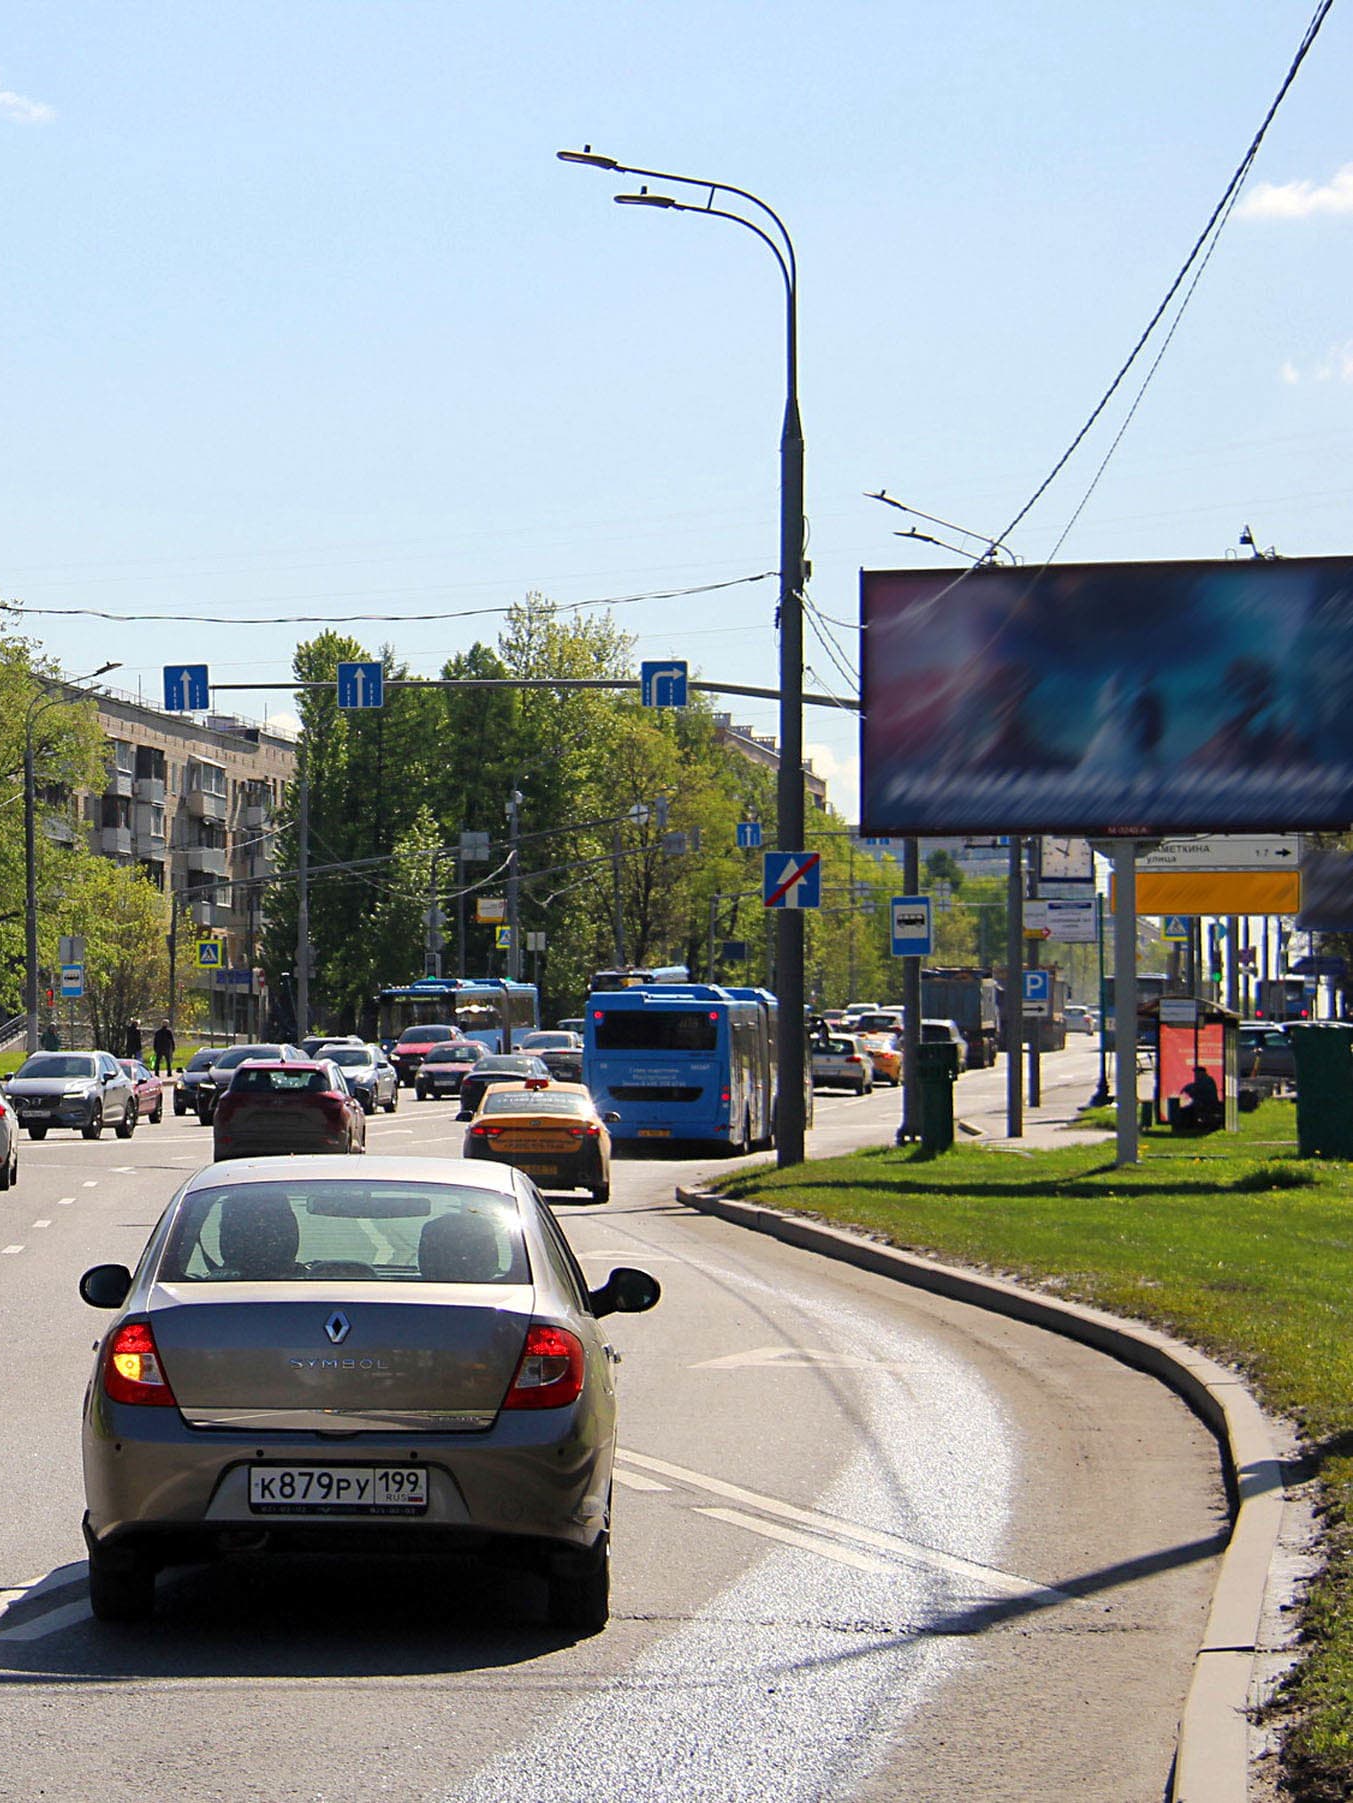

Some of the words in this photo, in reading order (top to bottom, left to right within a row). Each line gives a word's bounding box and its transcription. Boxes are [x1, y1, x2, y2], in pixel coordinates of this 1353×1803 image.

[290, 1358, 389, 1369] SYMBOL
[260, 1471, 370, 1500] К879РУ
[378, 1470, 420, 1493] 199
[385, 1493, 408, 1502] RUS
